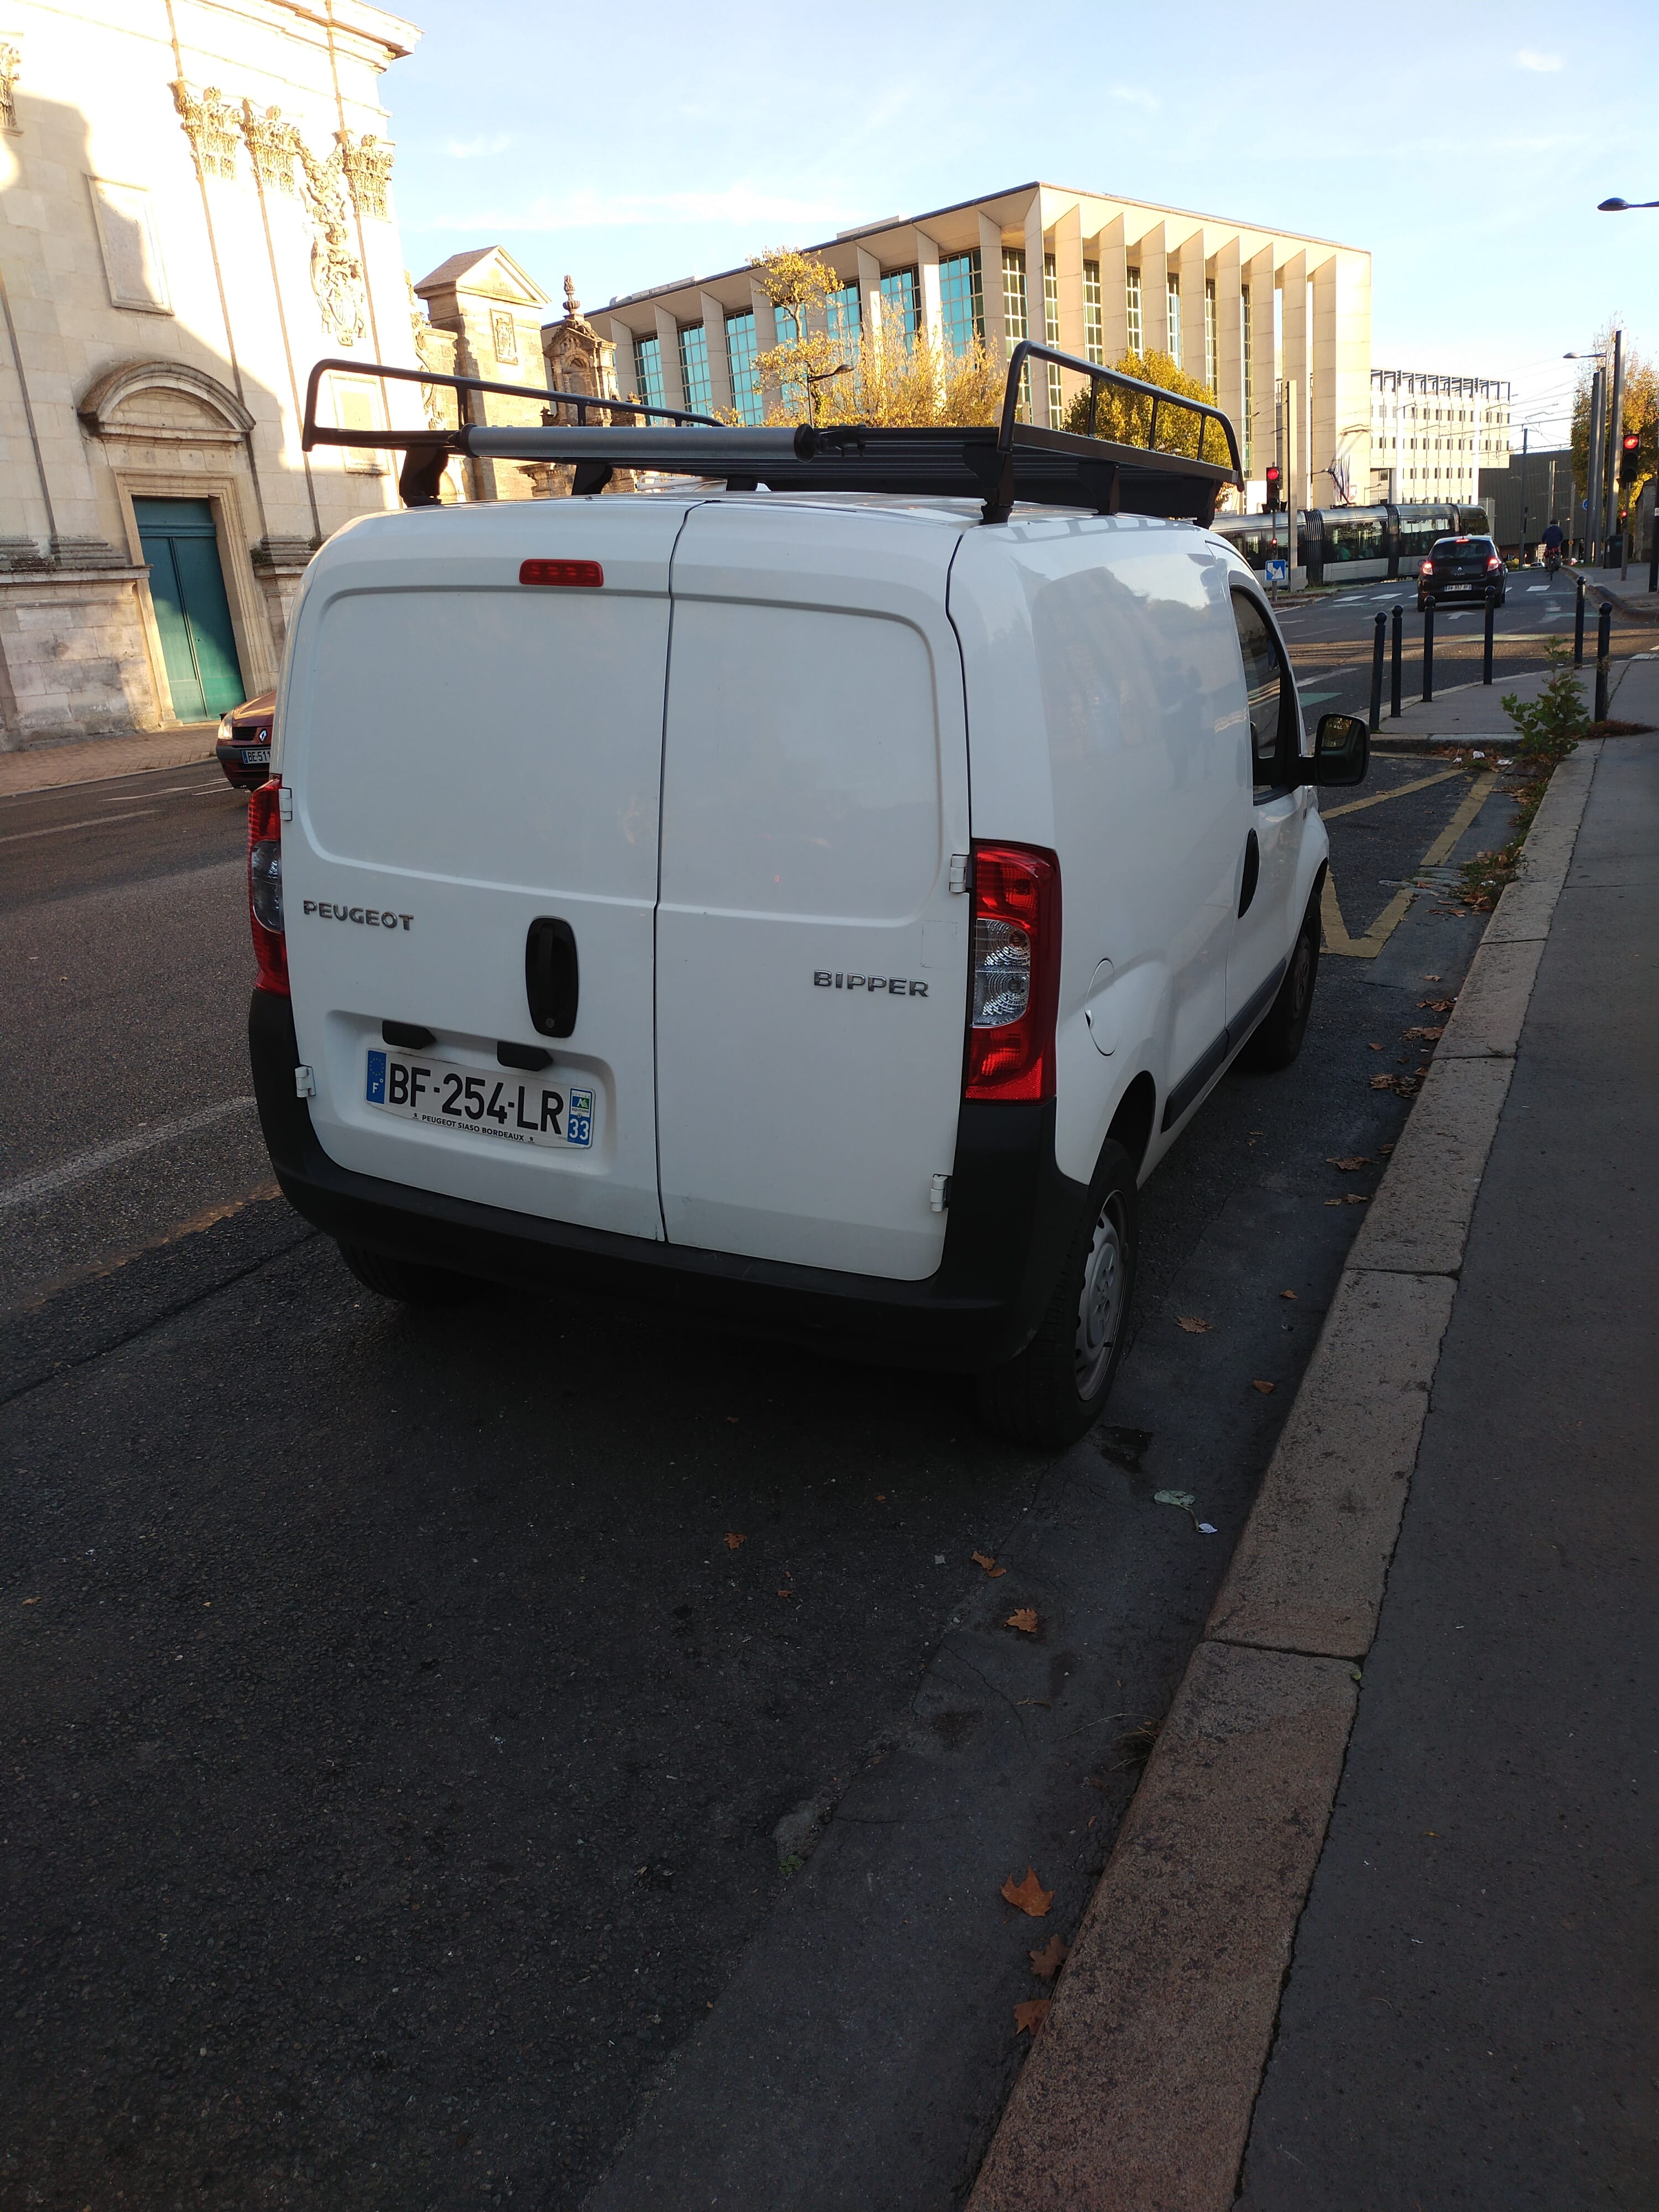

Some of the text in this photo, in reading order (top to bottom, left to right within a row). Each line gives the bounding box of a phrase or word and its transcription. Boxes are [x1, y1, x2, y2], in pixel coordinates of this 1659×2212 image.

[303, 899, 414, 930] PEUGEOT
[813, 969, 929, 997] BIPPER
[372, 1082, 379, 1093] F
[389, 1063, 564, 1135] BF-254-LR
[422, 1114, 524, 1141] PEUGEOT SIASO BORDEAUX
[569, 1118, 589, 1140] 33
